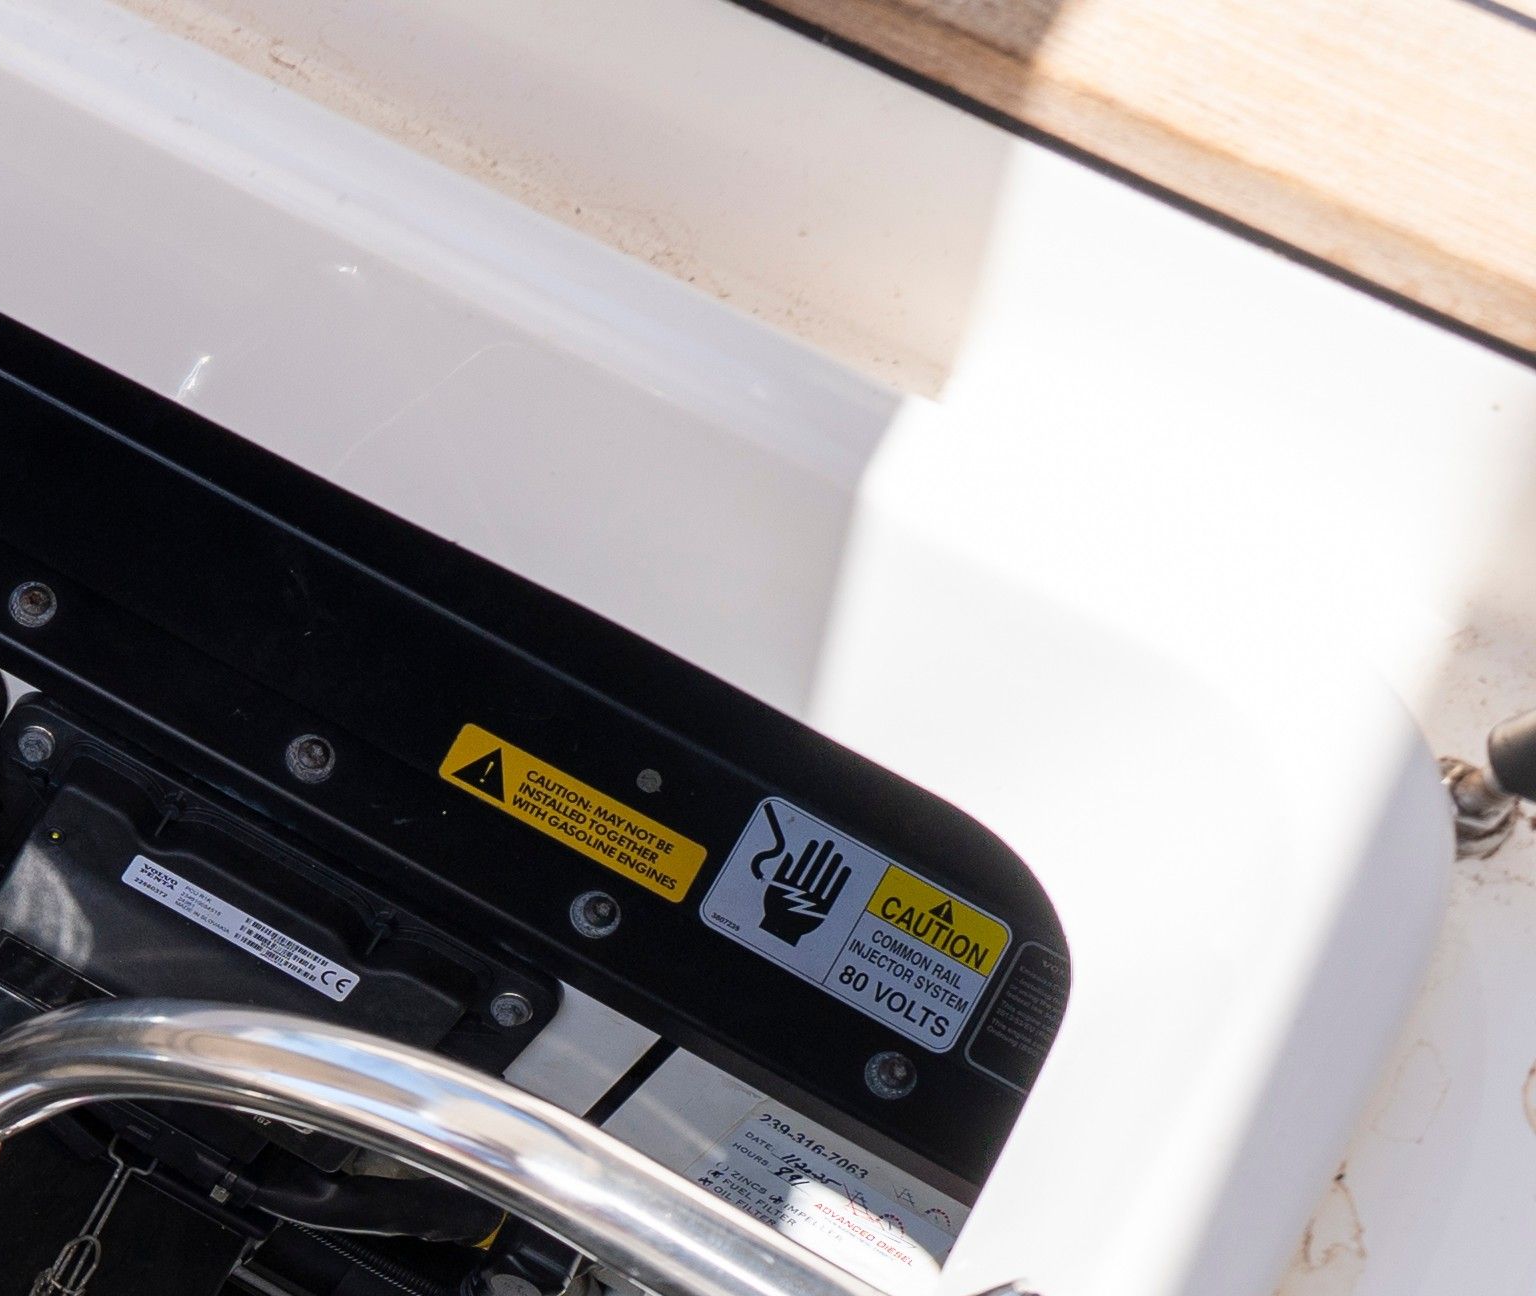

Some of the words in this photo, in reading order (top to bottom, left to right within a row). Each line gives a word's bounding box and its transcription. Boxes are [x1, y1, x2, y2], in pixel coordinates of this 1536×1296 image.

[510, 794, 548, 821] WITH
[546, 813, 617, 858] GASOLINE
[615, 850, 676, 889] ENGINES
[517, 781, 588, 826] INSTALLED
[587, 818, 659, 864] TOGETHER
[524, 768, 594, 812] CAUTION:
[593, 804, 626, 829] MAY
[623, 820, 657, 846] NOT
[655, 838, 674, 855] BE
[139, 867, 174, 889] PENTA
[142, 863, 177, 885] VOLVO
[870, 928, 933, 971] COMMON
[931, 962, 965, 989] RAIL
[878, 894, 989, 970] CAUTION
[836, 962, 871, 993] 80
[869, 980, 951, 1039] VOLTS
[847, 938, 914, 983] INJECTOR
[912, 974, 968, 1014] SYSTEM
[758, 1111, 869, 1181] 239-316-7063
[712, 1185, 733, 1201] OIL
[735, 1198, 776, 1227] FILTER
[721, 1177, 753, 1199] FUEL
[755, 1197, 796, 1227] FILTER
[730, 1169, 767, 1195] ZINCS
[813, 1201, 875, 1242] ADVANCED
[873, 1231, 915, 1268] DIESEL
